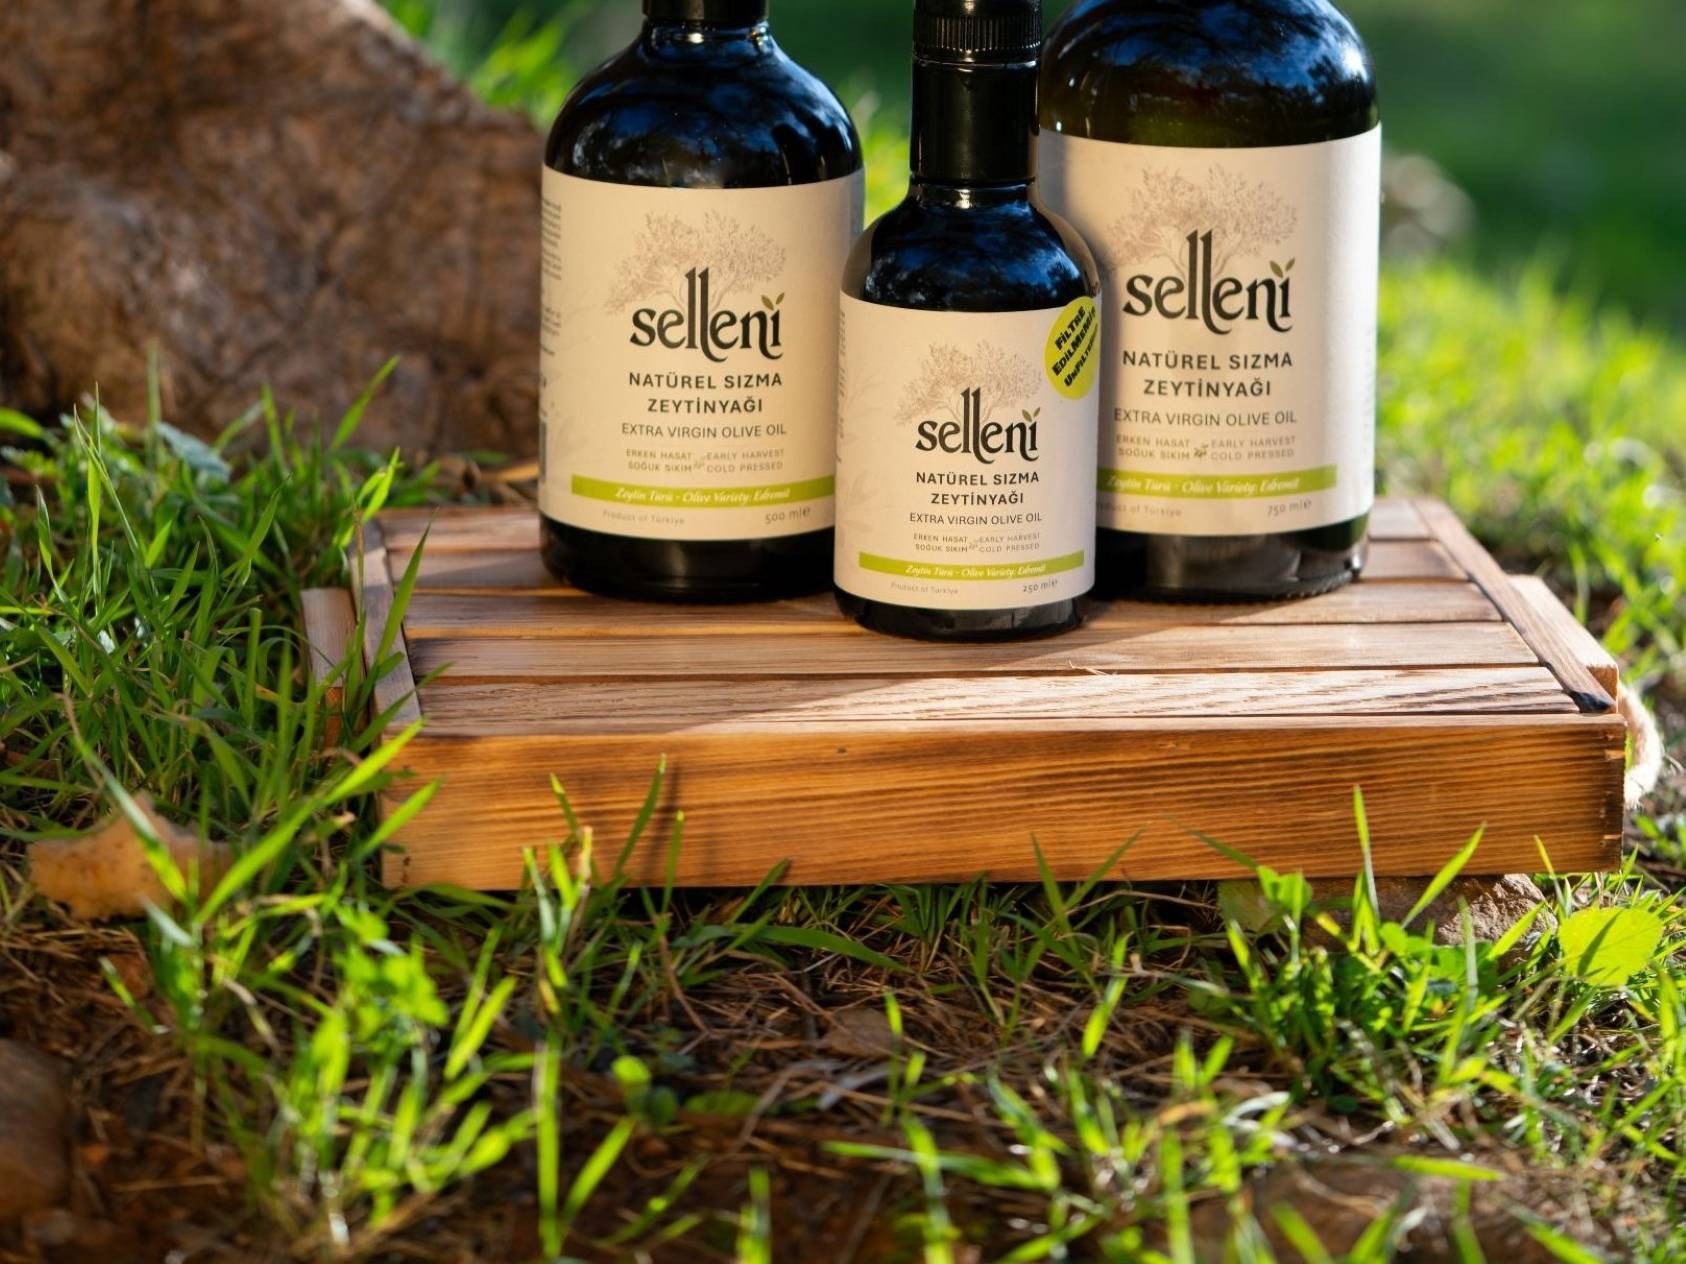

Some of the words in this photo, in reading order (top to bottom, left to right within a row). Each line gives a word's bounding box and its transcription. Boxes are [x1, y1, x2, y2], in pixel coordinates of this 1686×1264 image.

[1122, 229, 1296, 335] selleni
[630, 267, 785, 363] selleni
[1122, 350, 1221, 371] NATÜREL
[1228, 351, 1294, 371] SIZMA
[629, 371, 717, 390] NATÜREL
[724, 373, 783, 389] SIZMA
[1143, 377, 1272, 398] ZEYTİNYAĞI
[647, 396, 763, 414] ZEYTİNYAĞI
[1113, 407, 1161, 425] EXTRA
[1165, 410, 1221, 426] VIRGIN
[1225, 411, 1270, 426] OLIVE
[1274, 410, 1297, 424] OIL
[621, 422, 663, 438] EXTRA
[667, 426, 717, 439] VIRGIN
[722, 424, 762, 439] OLIVE
[766, 423, 787, 436] OIL
[915, 387, 1041, 464] selleni
[1116, 435, 1151, 447] ERKEN
[1155, 436, 1190, 448] HASAT
[1211, 439, 1246, 449] EARLY
[1250, 435, 1296, 447] HARVEST
[626, 448, 657, 458] ERKEN
[660, 450, 693, 461] HASAT
[706, 452, 738, 461] EARLY
[742, 448, 785, 459] HARVEST
[1210, 450, 1243, 461] COLD
[1247, 448, 1294, 460] PRESSED
[706, 464, 736, 474] COLD
[740, 461, 784, 472] PRESSED
[916, 471, 988, 486] NATÜREL
[993, 472, 1040, 486] SIZMA
[1182, 479, 1214, 494] Olive
[682, 490, 711, 504] Olive
[930, 491, 1024, 506] ZEYTİNYAĞI
[1266, 504, 1286, 517] 750
[765, 512, 786, 524] 500
[909, 512, 945, 524] EXTRA
[948, 515, 988, 526] VIRGIN
[991, 514, 1023, 525] OLIVE
[1025, 511, 1042, 523] OIL
[913, 532, 939, 542] ERKEN
[942, 534, 968, 543] HASAT
[978, 535, 1004, 544] EARLY
[1007, 532, 1040, 542] HARVEST
[978, 545, 1002, 553] COLD
[1006, 542, 1040, 552] PRESSED
[961, 567, 984, 578] Olive
[1022, 584, 1039, 593] 250
